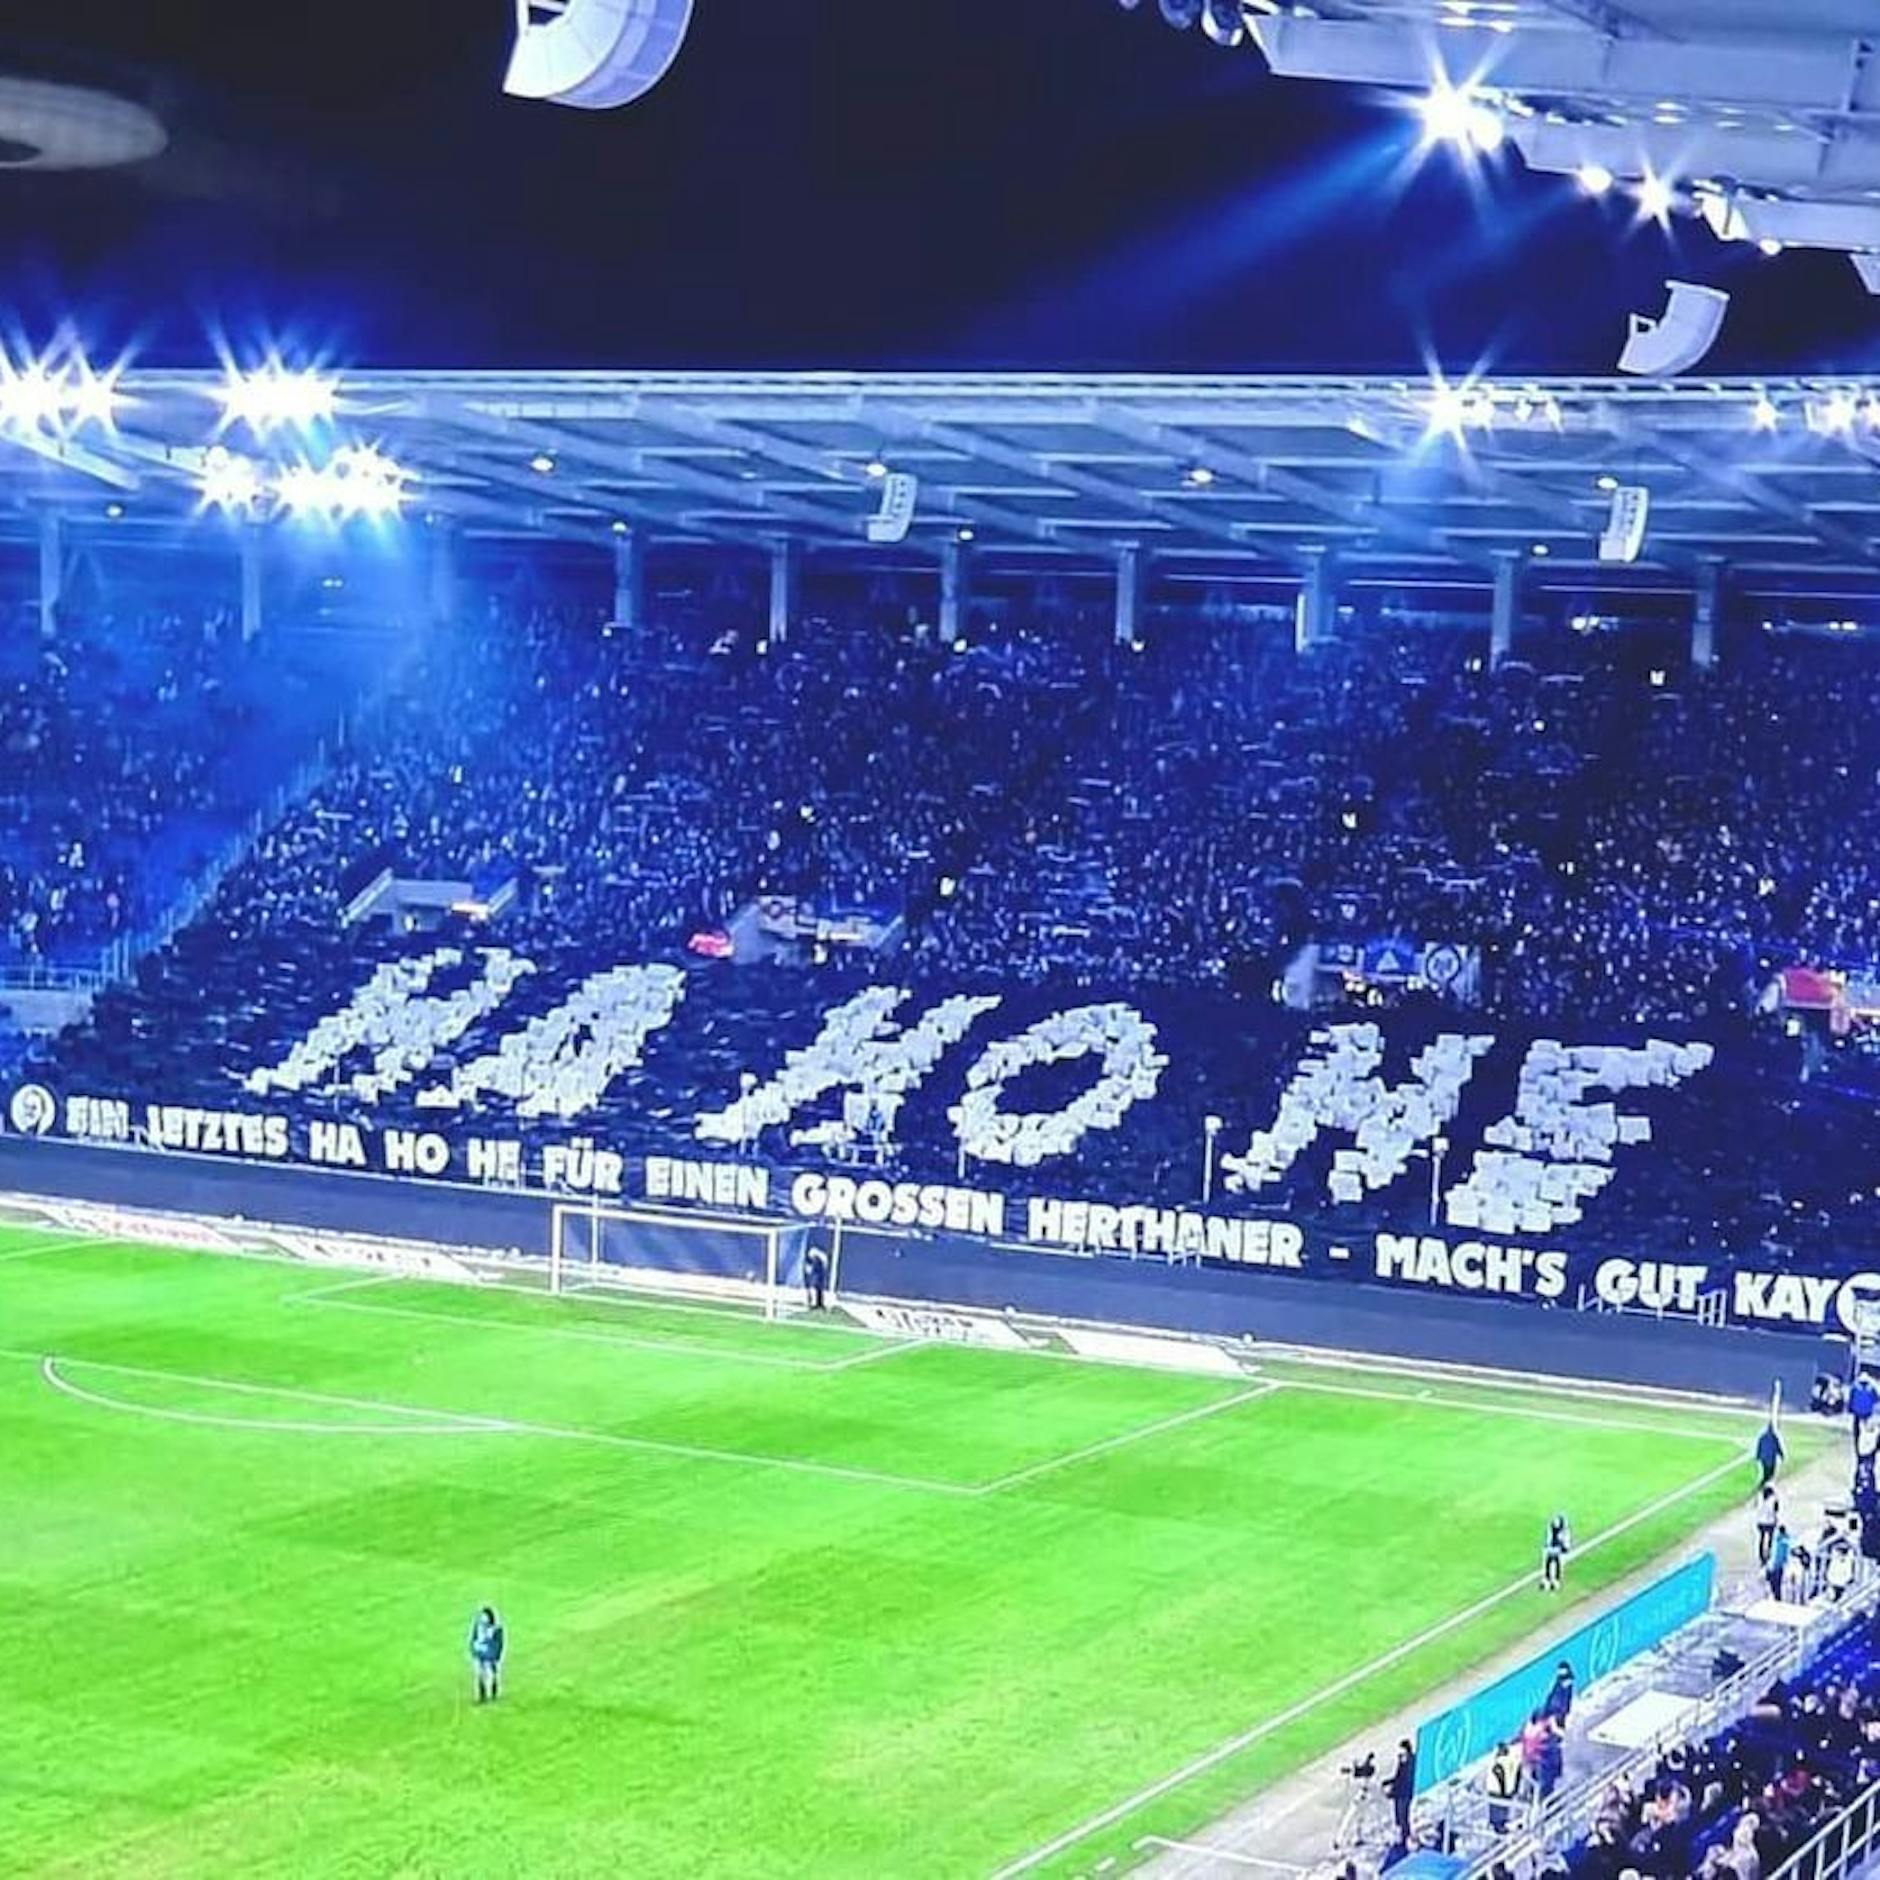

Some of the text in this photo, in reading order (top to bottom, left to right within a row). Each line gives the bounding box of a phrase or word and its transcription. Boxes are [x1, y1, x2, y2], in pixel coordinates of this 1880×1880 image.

[244, 947, 687, 1118] HA
[694, 986, 1169, 1166] HO
[146, 1104, 289, 1156] LETZTES
[309, 1120, 366, 1166] HA
[384, 1129, 450, 1174] HO
[467, 1138, 521, 1182] HE
[542, 1137, 624, 1194] FÜR
[645, 1156, 770, 1208] EINEN
[791, 1173, 1005, 1236] GROSSEN
[1027, 1197, 1304, 1268] HERTHANER
[1328, 1245, 1350, 1259] -
[1375, 1233, 1568, 1297] MACH'S
[1595, 1258, 1708, 1310] GUT
[1733, 1270, 1842, 1323] KAY
